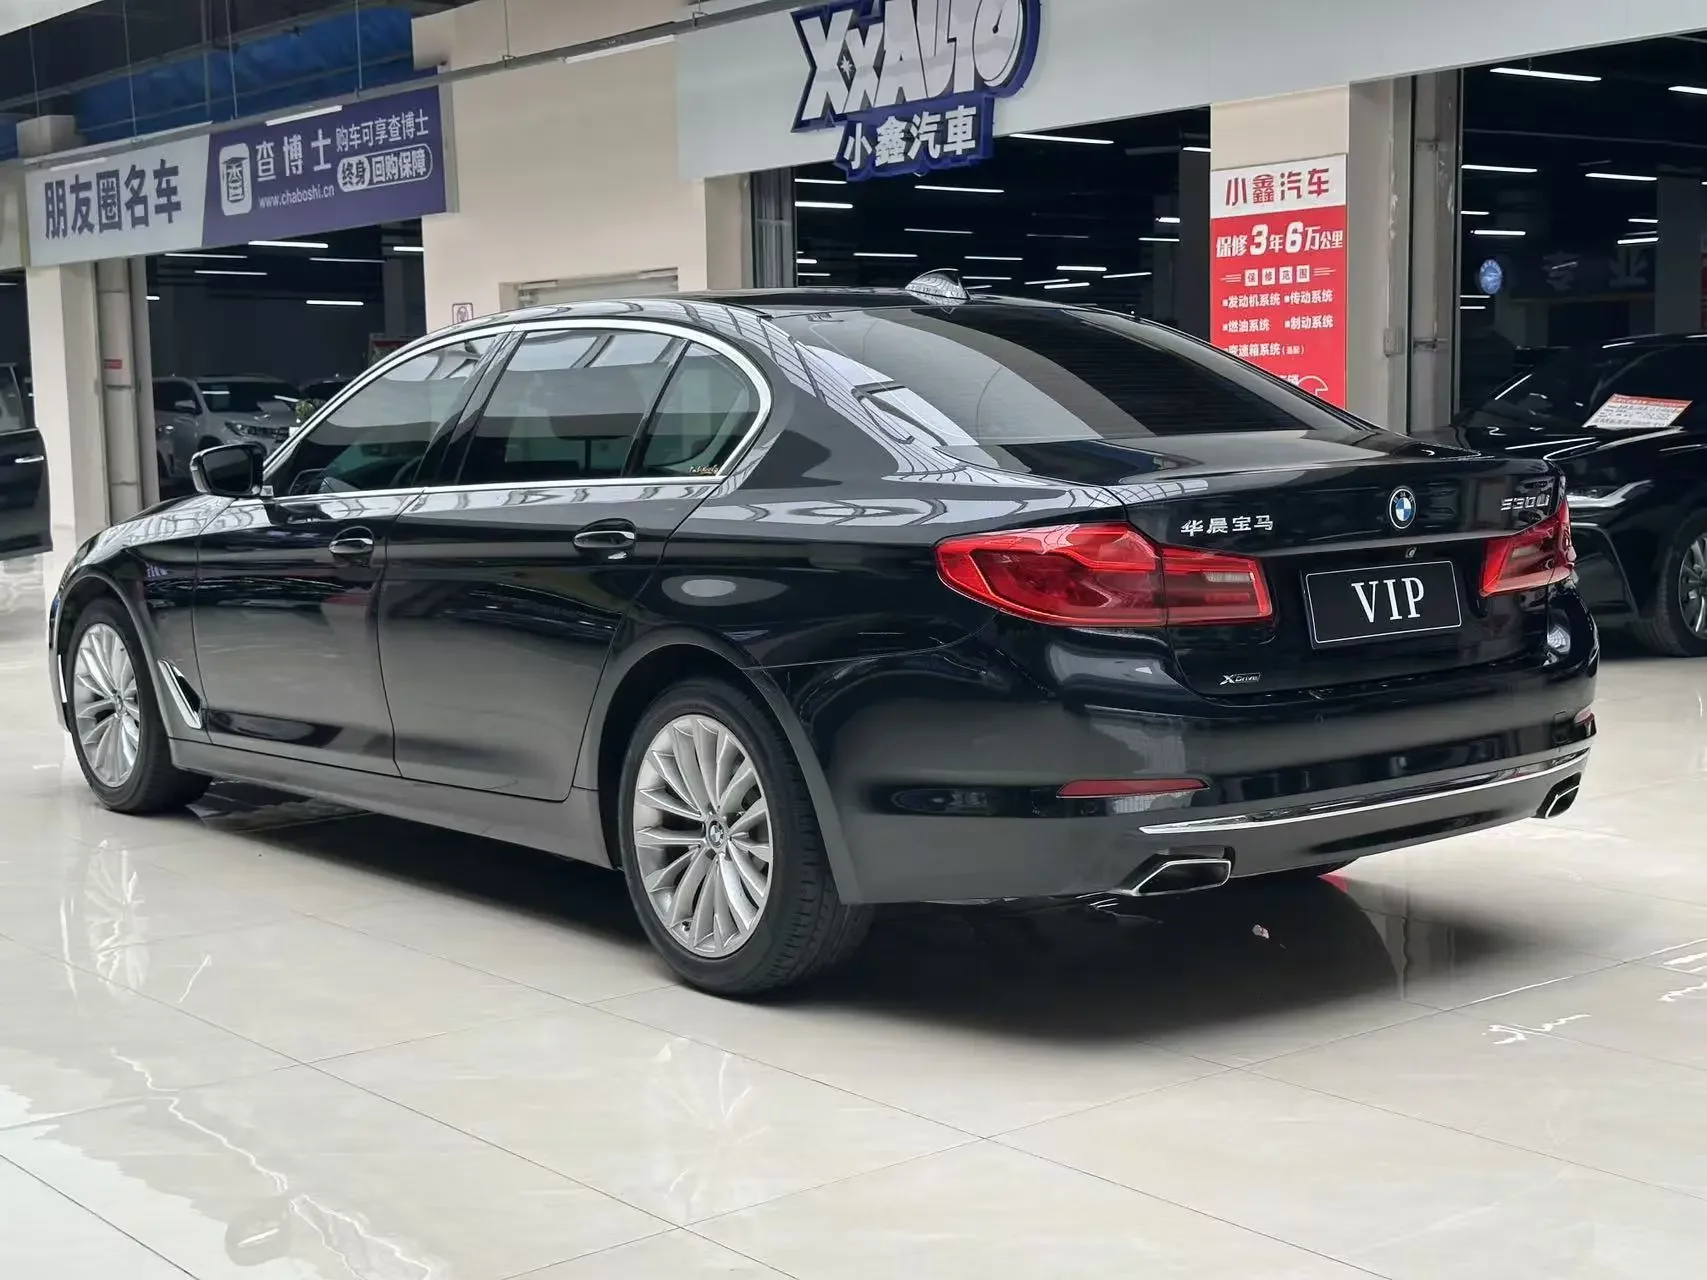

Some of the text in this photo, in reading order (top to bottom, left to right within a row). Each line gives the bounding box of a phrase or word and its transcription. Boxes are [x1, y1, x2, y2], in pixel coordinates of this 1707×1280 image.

[336, 109, 429, 152] 购车可享查博士
[844, 105, 976, 169] 小鑫汽車
[256, 129, 331, 182] 查博士
[341, 149, 427, 187] 终身 回购保障
[45, 158, 182, 239] 朋友圈名车
[259, 185, 335, 208] www.chaboshi.cn
[1225, 168, 1329, 206] 小鑫汽车
[1216, 221, 1343, 258] 保修3年6万公里
[1228, 289, 1333, 308] 发动机系统 传动系统
[1228, 315, 1333, 333] 燃油系统 制动系统
[1181, 515, 1273, 537] 华晨宝马
[1351, 577, 1424, 622] VIP
